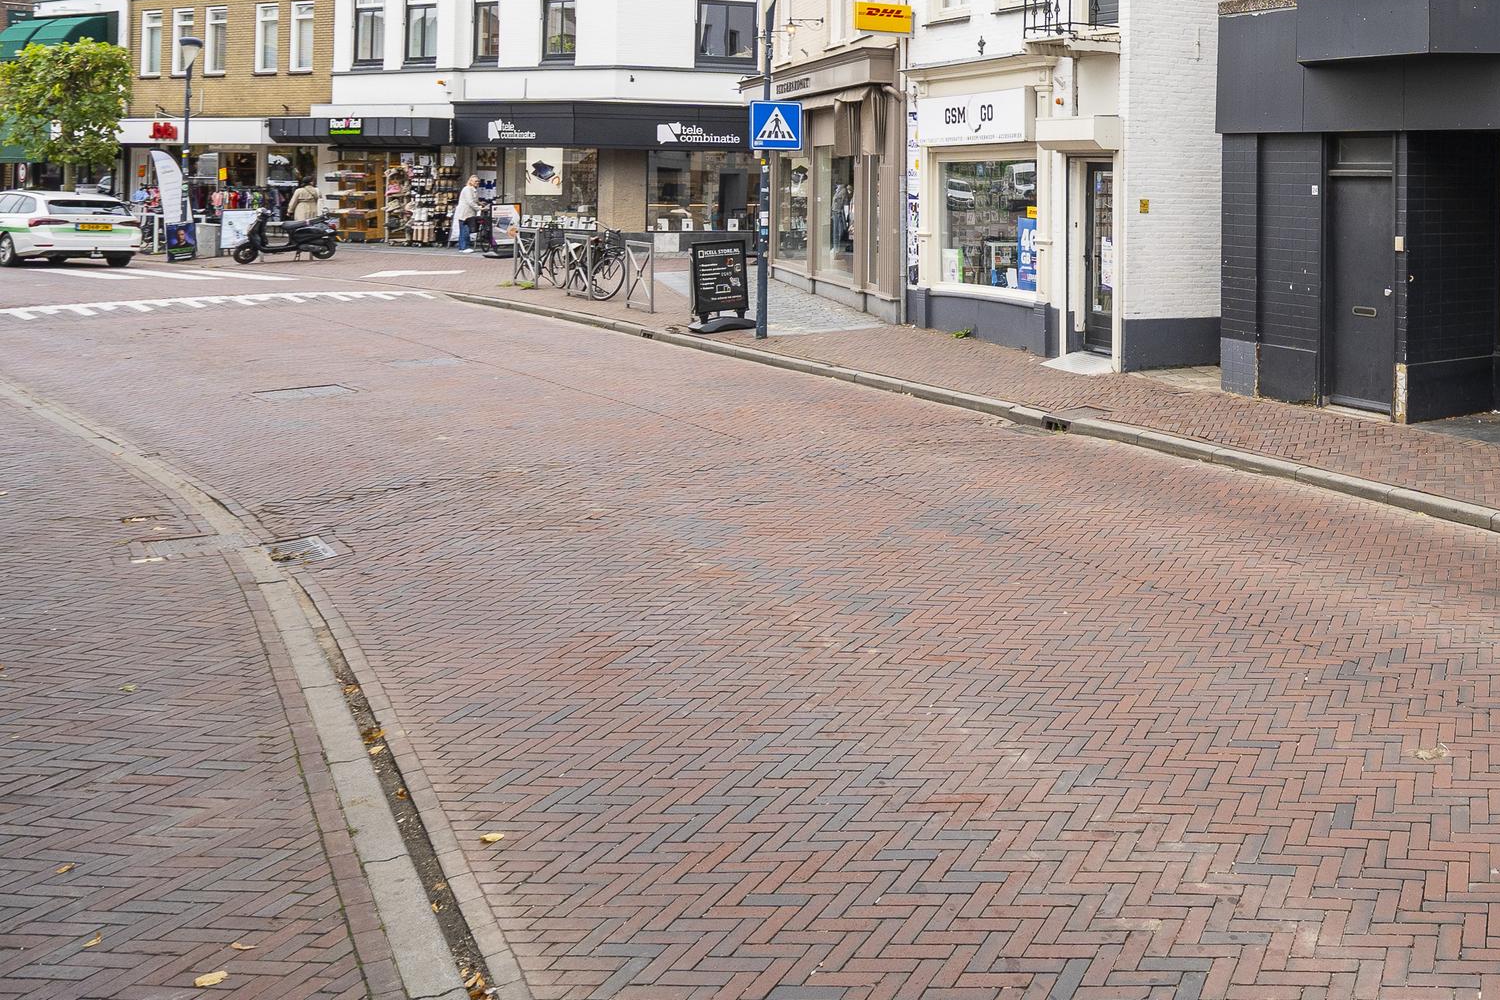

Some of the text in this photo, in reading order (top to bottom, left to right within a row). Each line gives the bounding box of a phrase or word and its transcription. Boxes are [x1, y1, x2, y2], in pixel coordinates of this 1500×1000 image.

[866, 7, 904, 18] DHL
[944, 103, 994, 125] GSM GO
[501, 121, 515, 131] tele
[681, 124, 703, 135] tele
[500, 129, 536, 140] combinatie
[679, 133, 741, 144] combinatie
